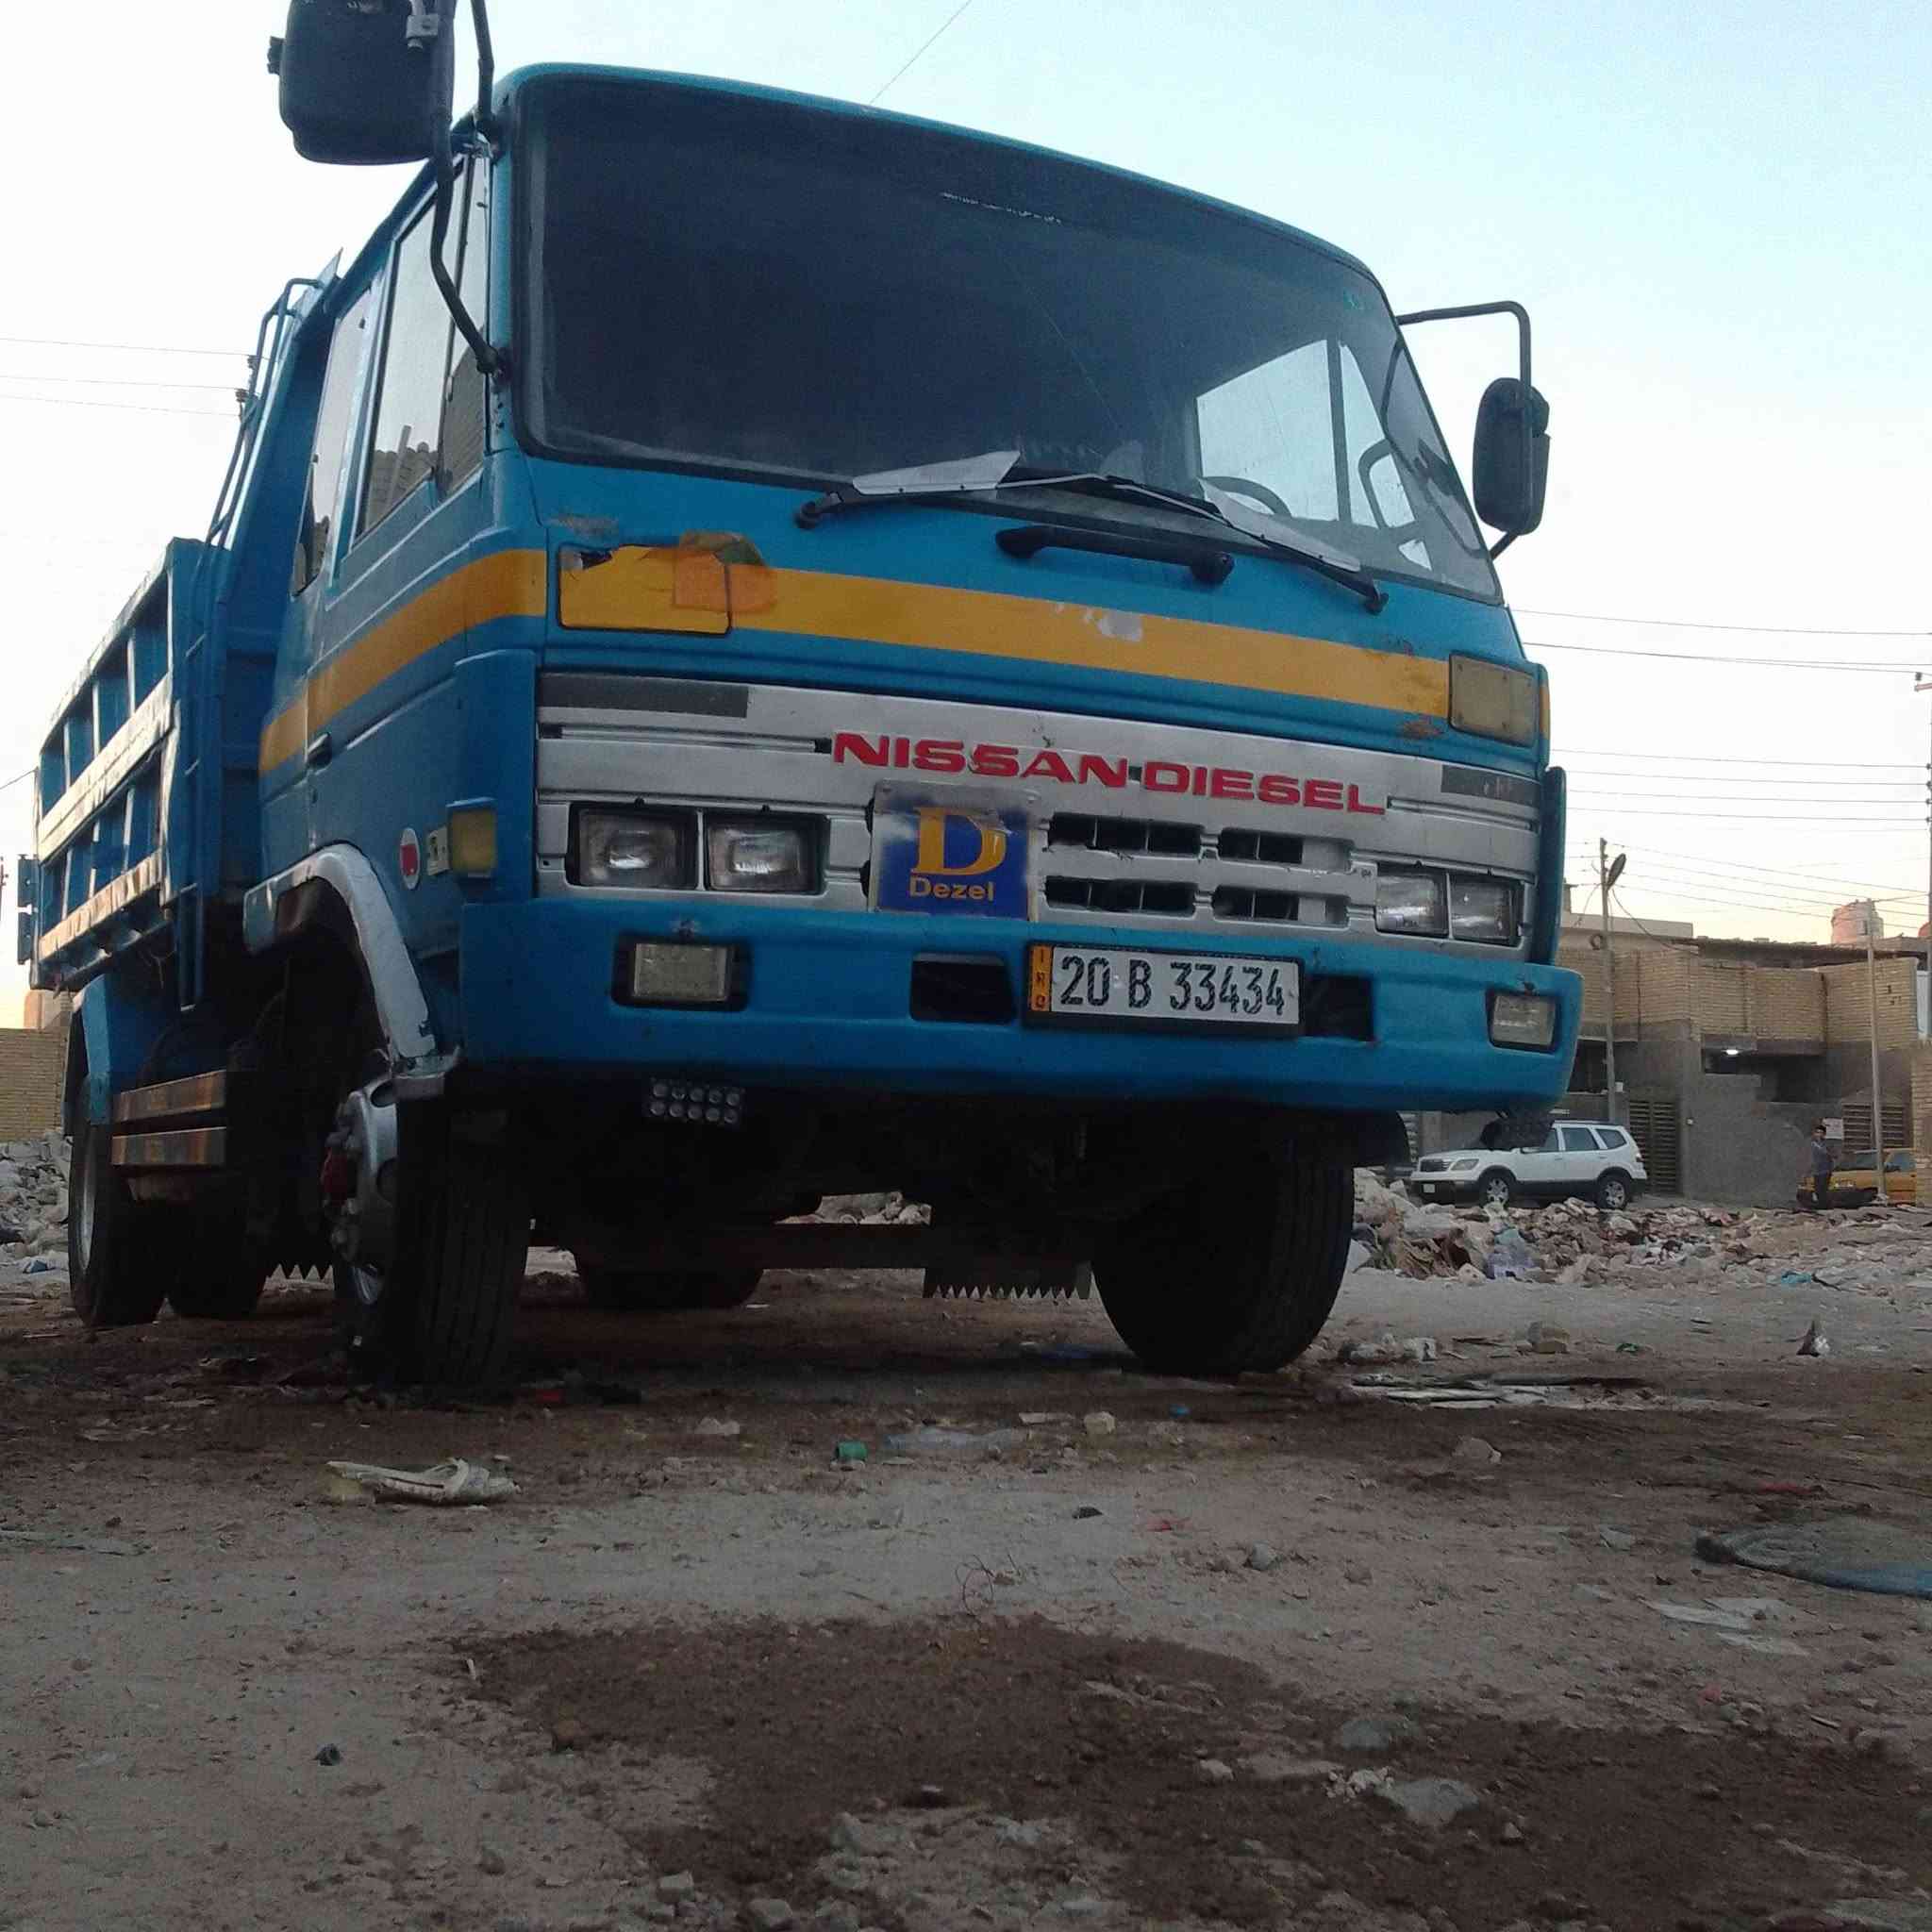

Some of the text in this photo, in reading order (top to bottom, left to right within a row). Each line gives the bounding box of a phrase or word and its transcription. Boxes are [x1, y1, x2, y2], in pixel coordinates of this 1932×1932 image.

[833, 732, 1386, 815] NISSAN DIESEL
[910, 807, 1008, 875] D
[908, 875, 994, 902] Dezel
[1060, 956, 1285, 1015] 20 B 33434
